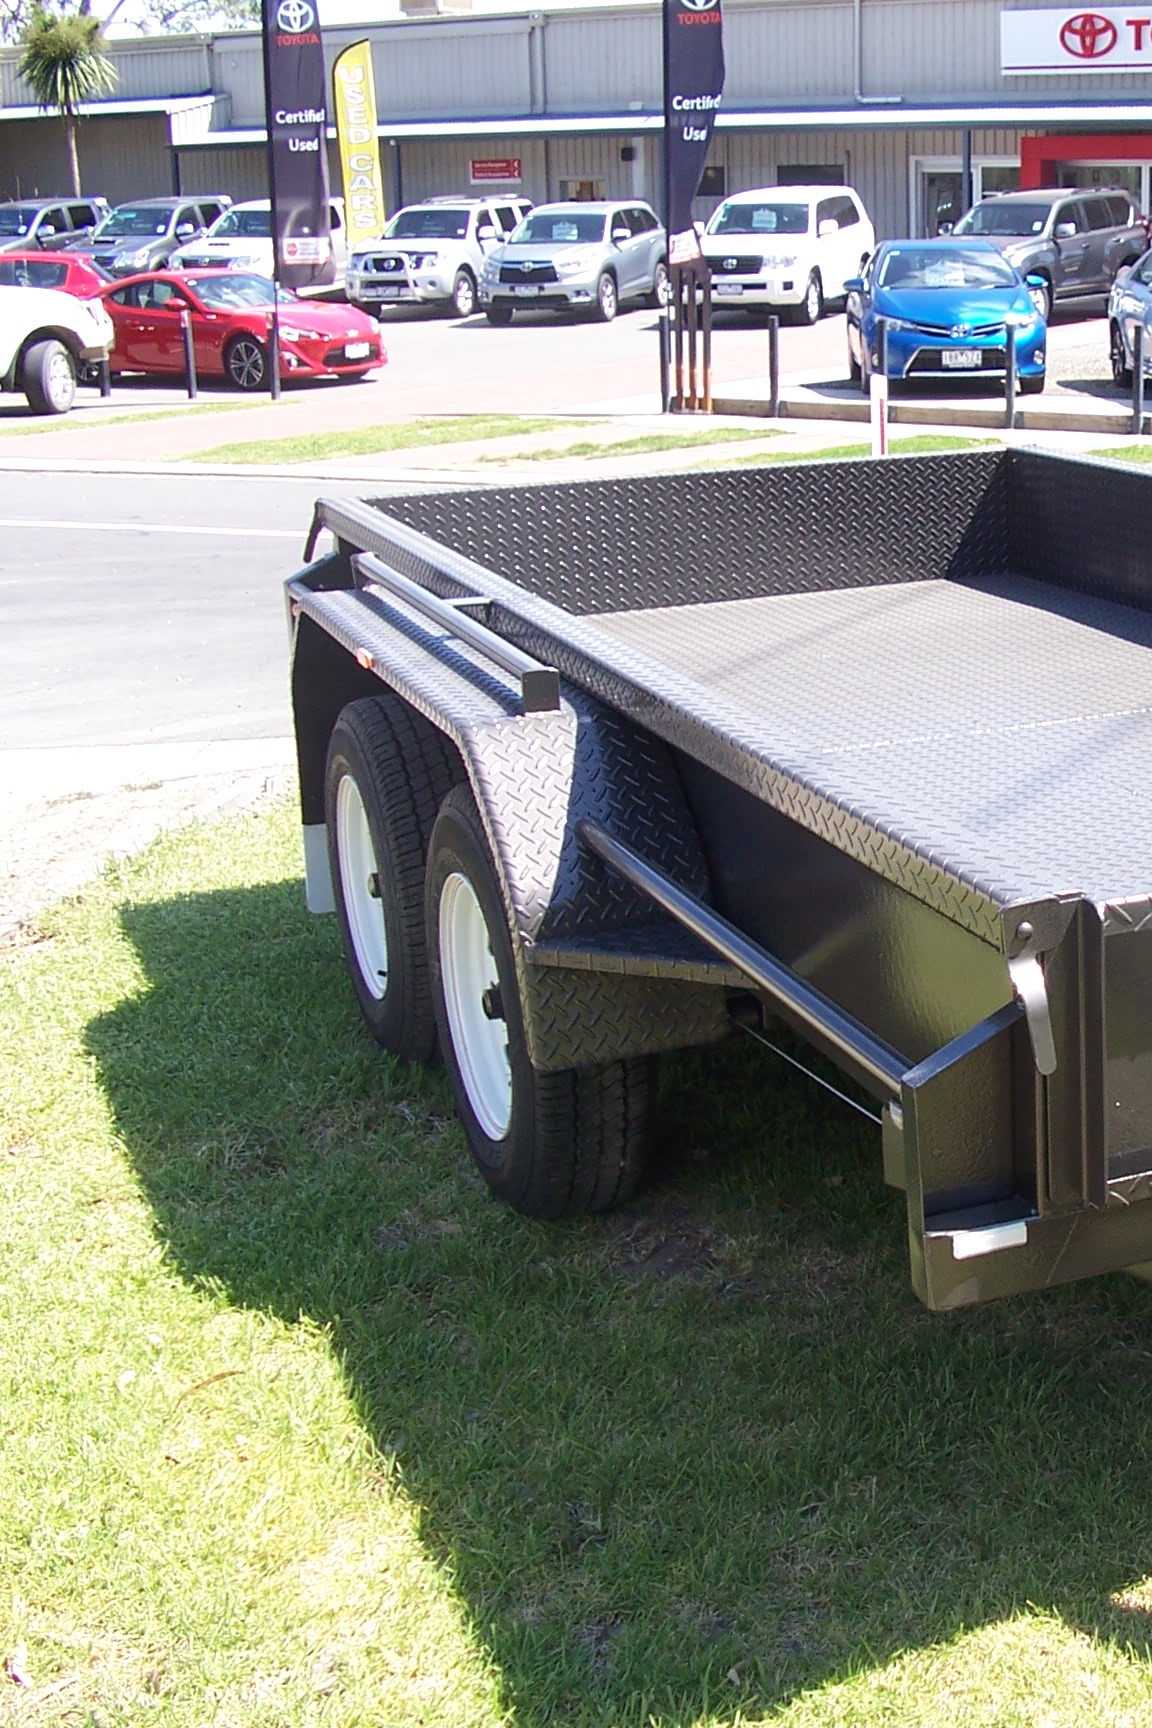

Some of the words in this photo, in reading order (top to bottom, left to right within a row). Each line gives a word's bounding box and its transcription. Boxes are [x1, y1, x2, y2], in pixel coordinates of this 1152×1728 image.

[677, 12, 721, 25] TOYOTA
[276, 33, 320, 46] TOYOTA
[340, 66, 373, 145] USED
[288, 137, 319, 151] Used
[348, 153, 378, 229] CARS
